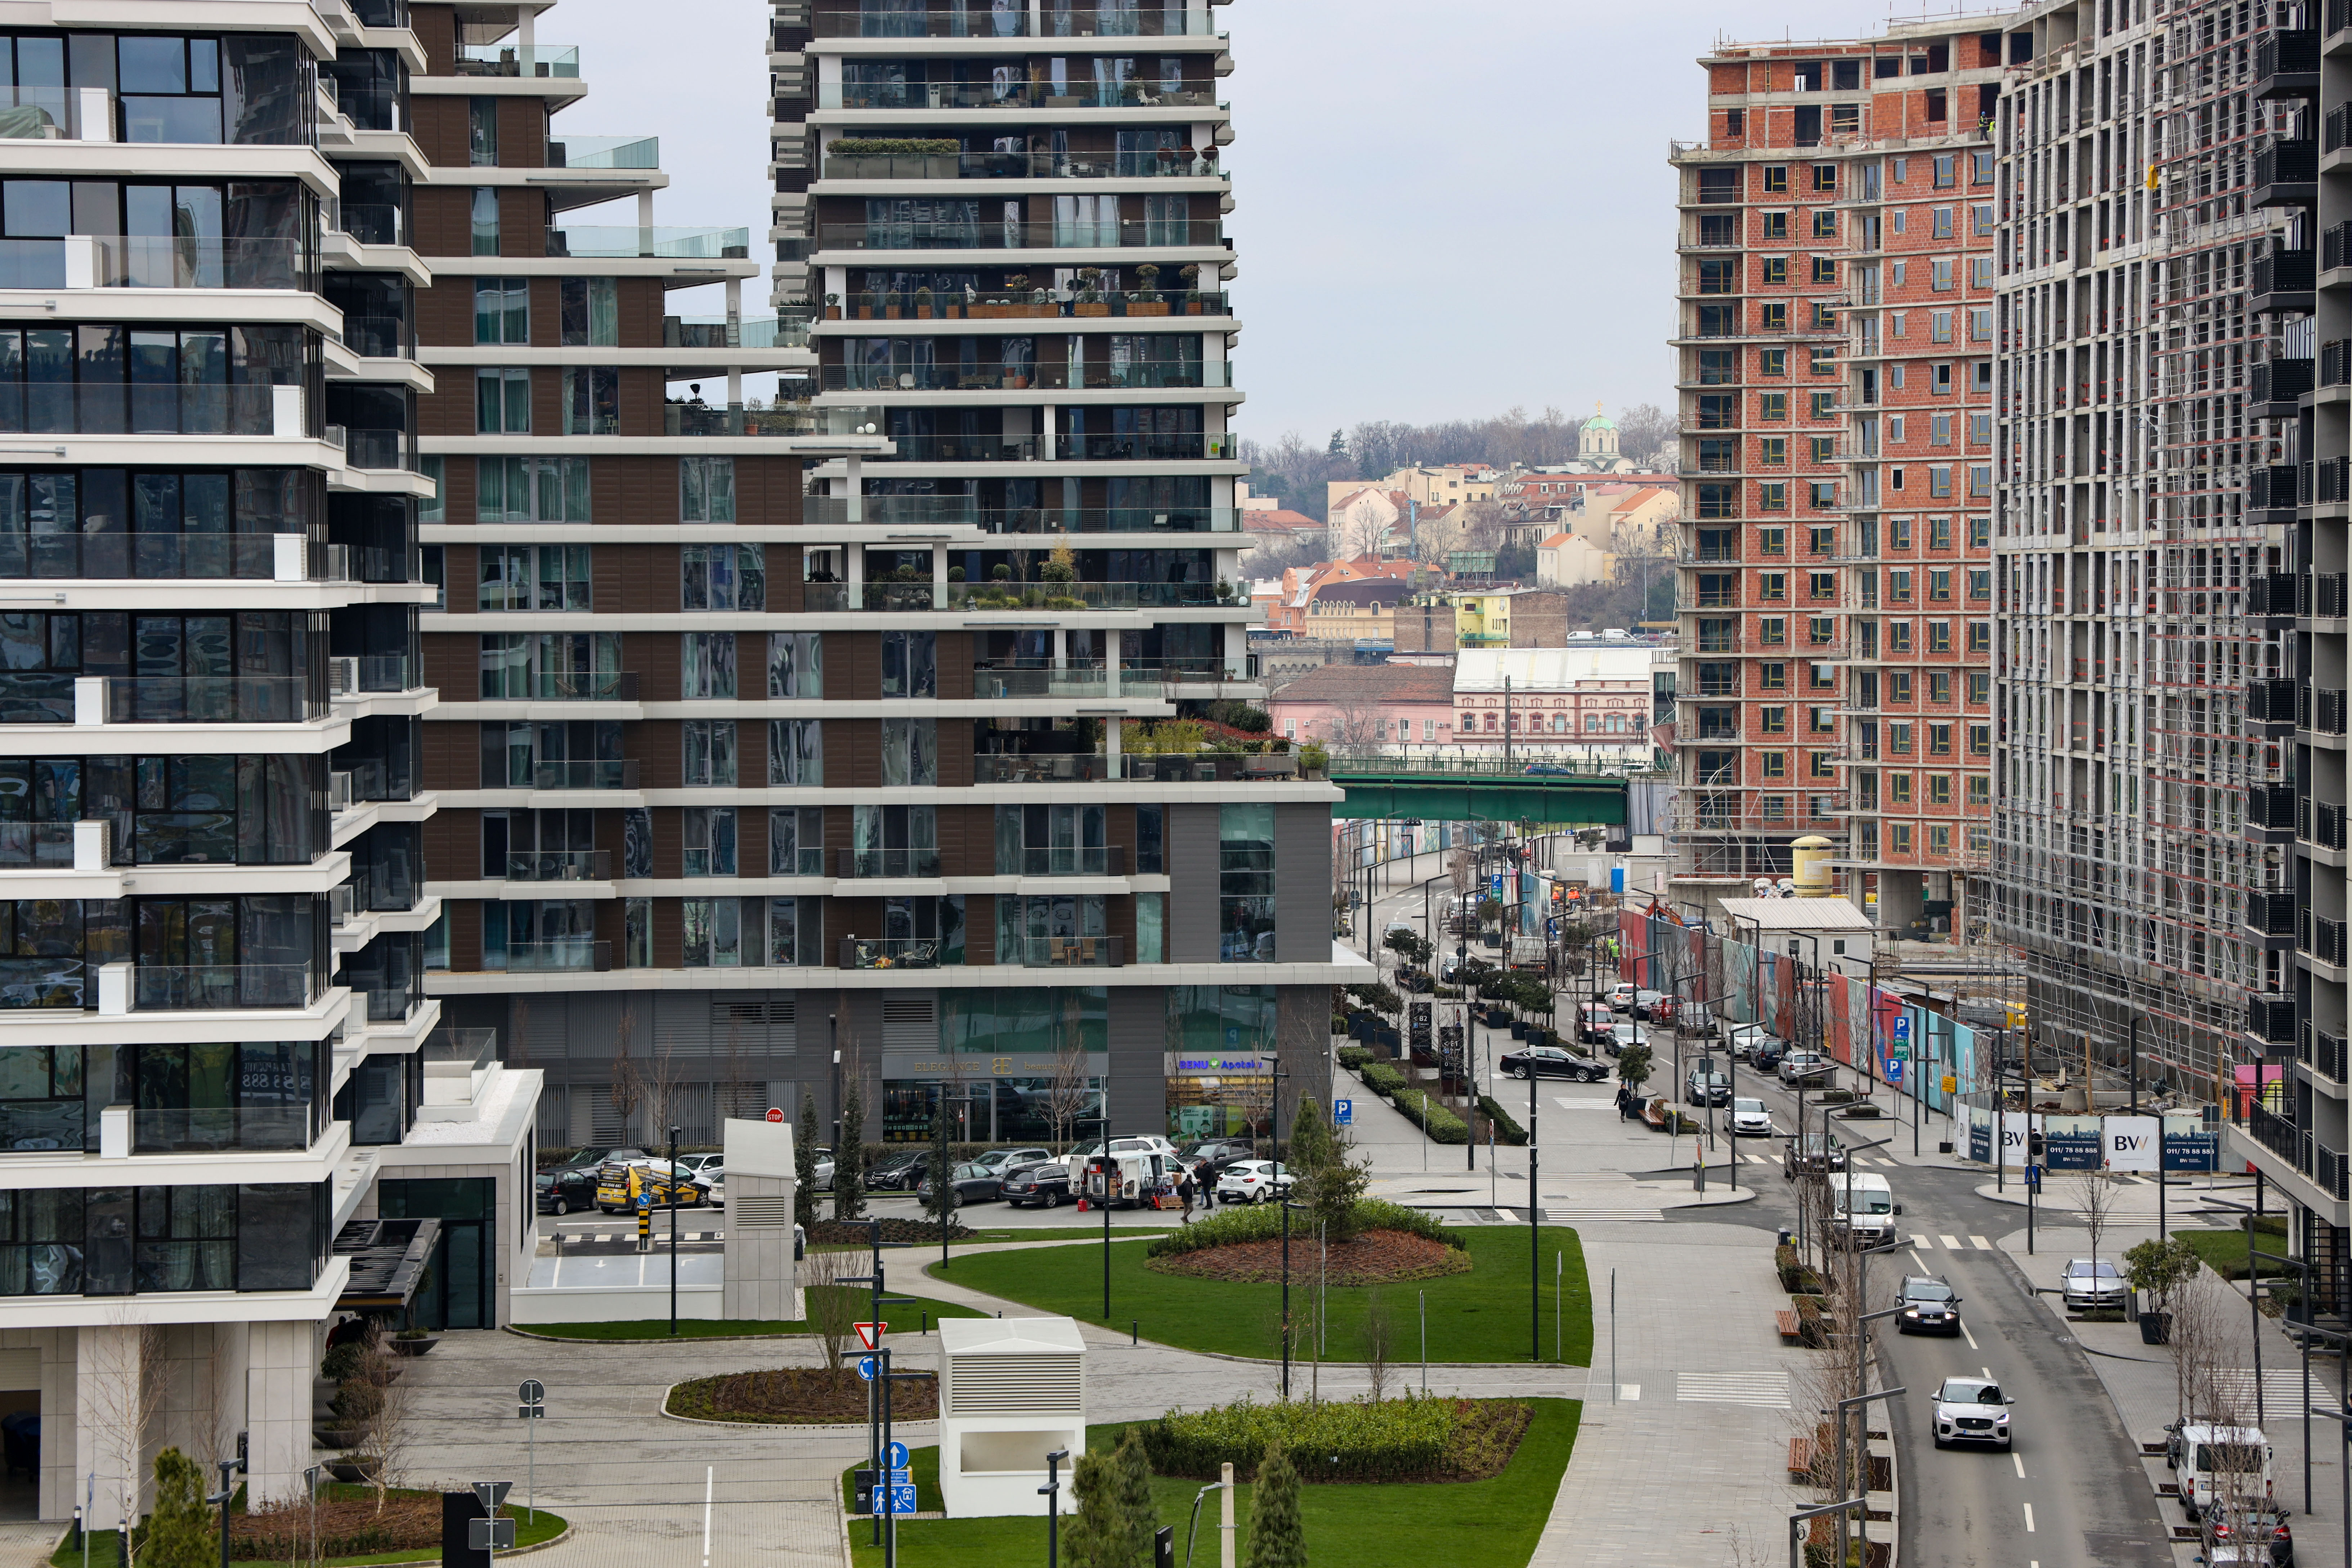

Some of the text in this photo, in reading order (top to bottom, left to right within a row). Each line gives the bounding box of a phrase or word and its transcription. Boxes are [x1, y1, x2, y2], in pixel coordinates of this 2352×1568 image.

[1898, 1018, 1905, 1030] P
[914, 1062, 980, 1071] ELEGANCE
[1024, 1062, 1056, 1072] beauty
[1179, 1060, 1208, 1069] BENU
[1890, 1061, 1898, 1072] P
[1339, 1102, 1348, 1114] P
[1165, 1540, 1171, 1555] BW
